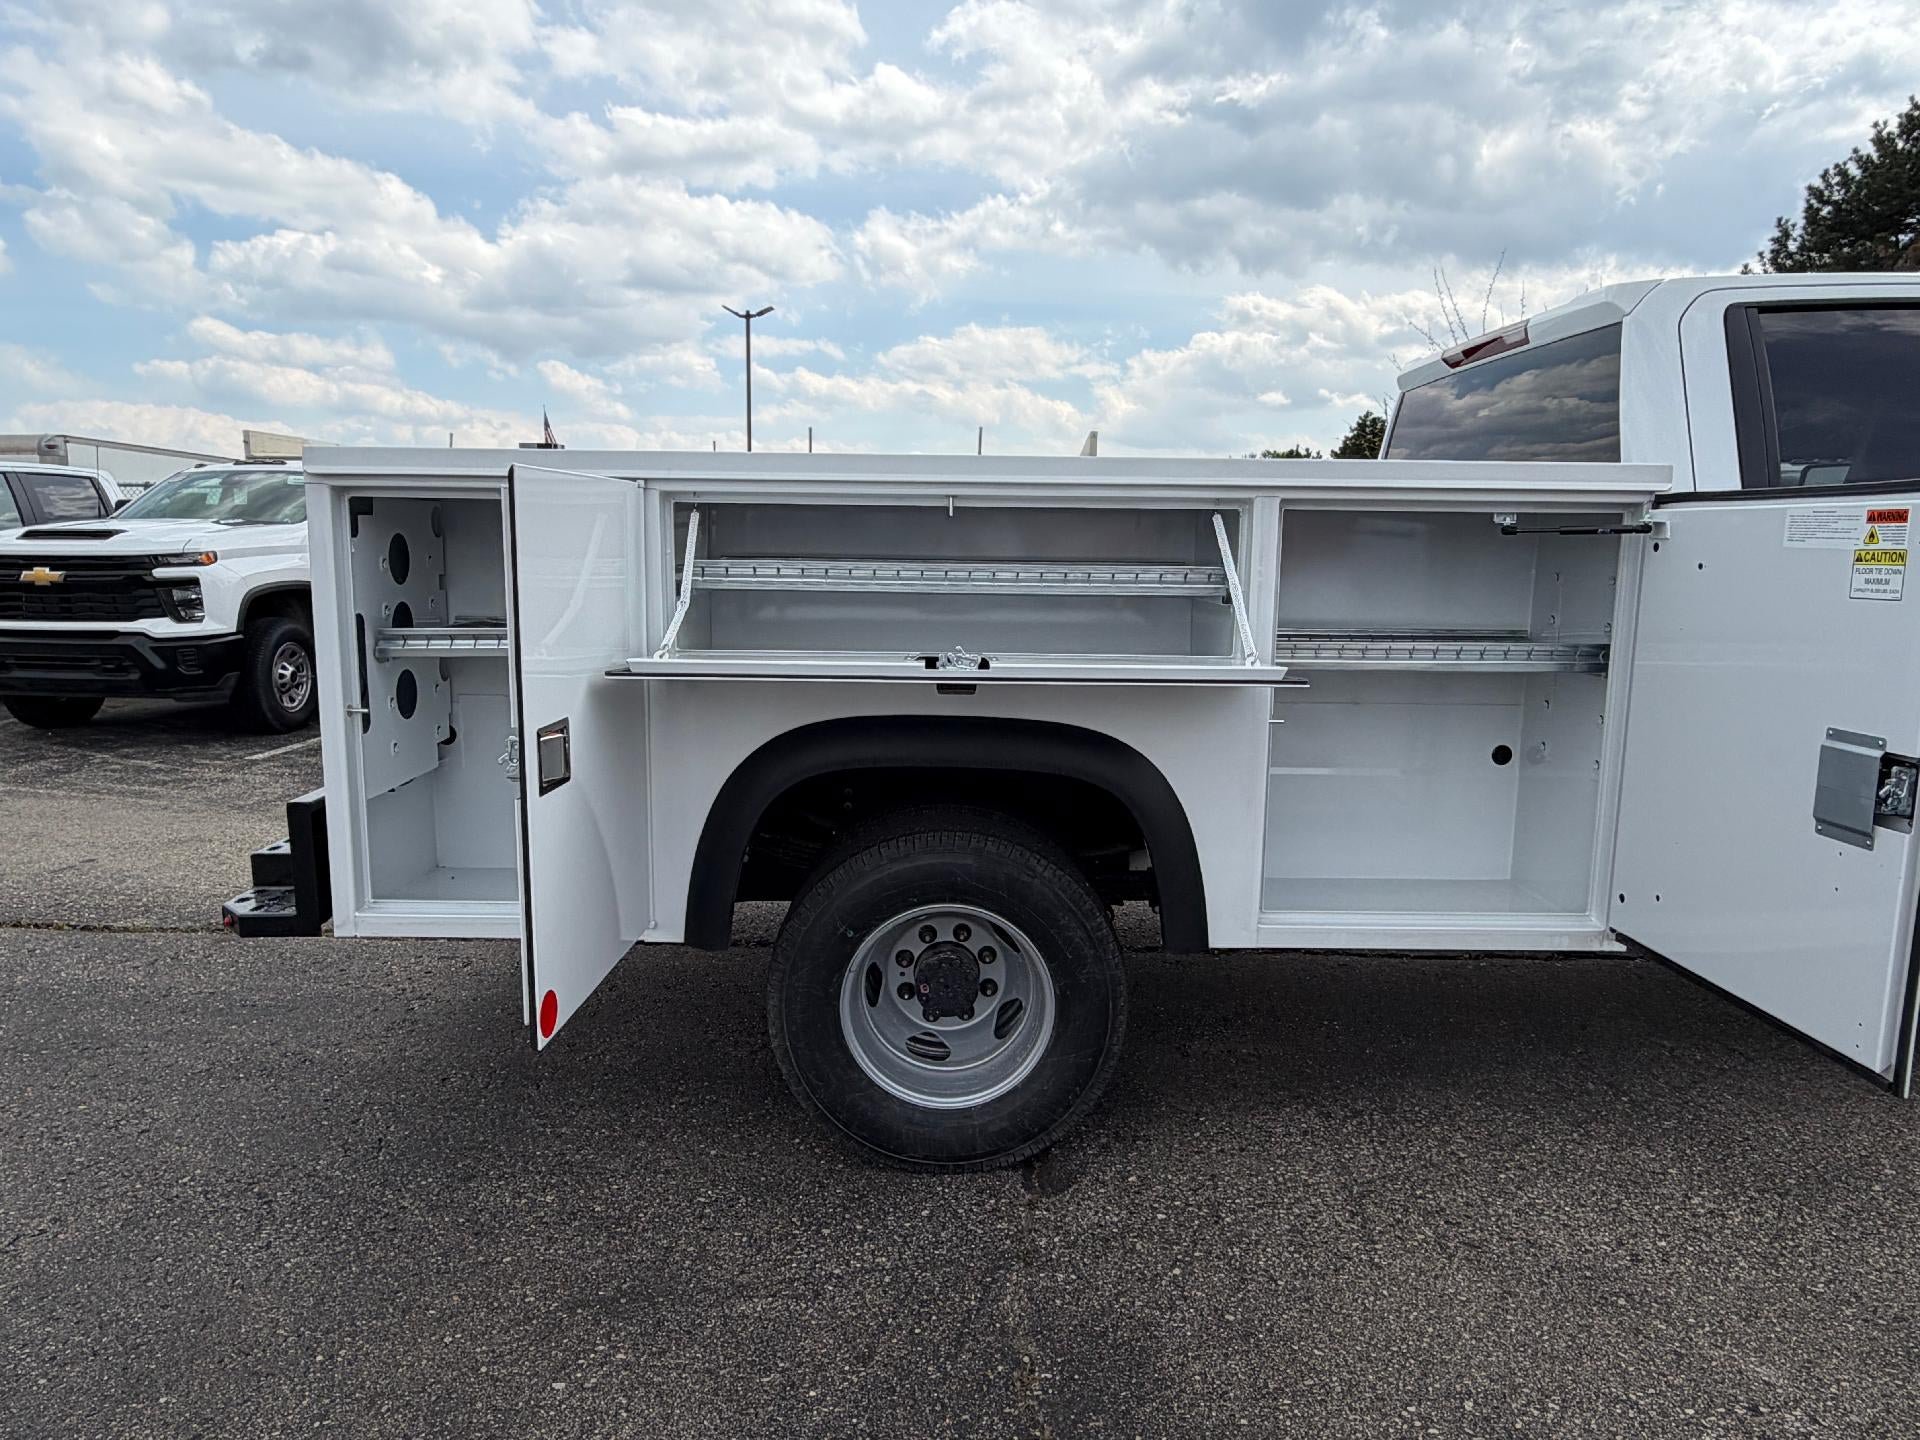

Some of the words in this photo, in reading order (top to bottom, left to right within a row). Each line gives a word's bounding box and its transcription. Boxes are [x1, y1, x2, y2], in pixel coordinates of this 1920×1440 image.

[1876, 510, 1908, 522] WARNING
[1863, 551, 1905, 563] CAUTION
[1855, 567, 1874, 575] FLOOR
[1874, 567, 1884, 575] TIE
[1864, 577, 1891, 585] MAXIMUM
